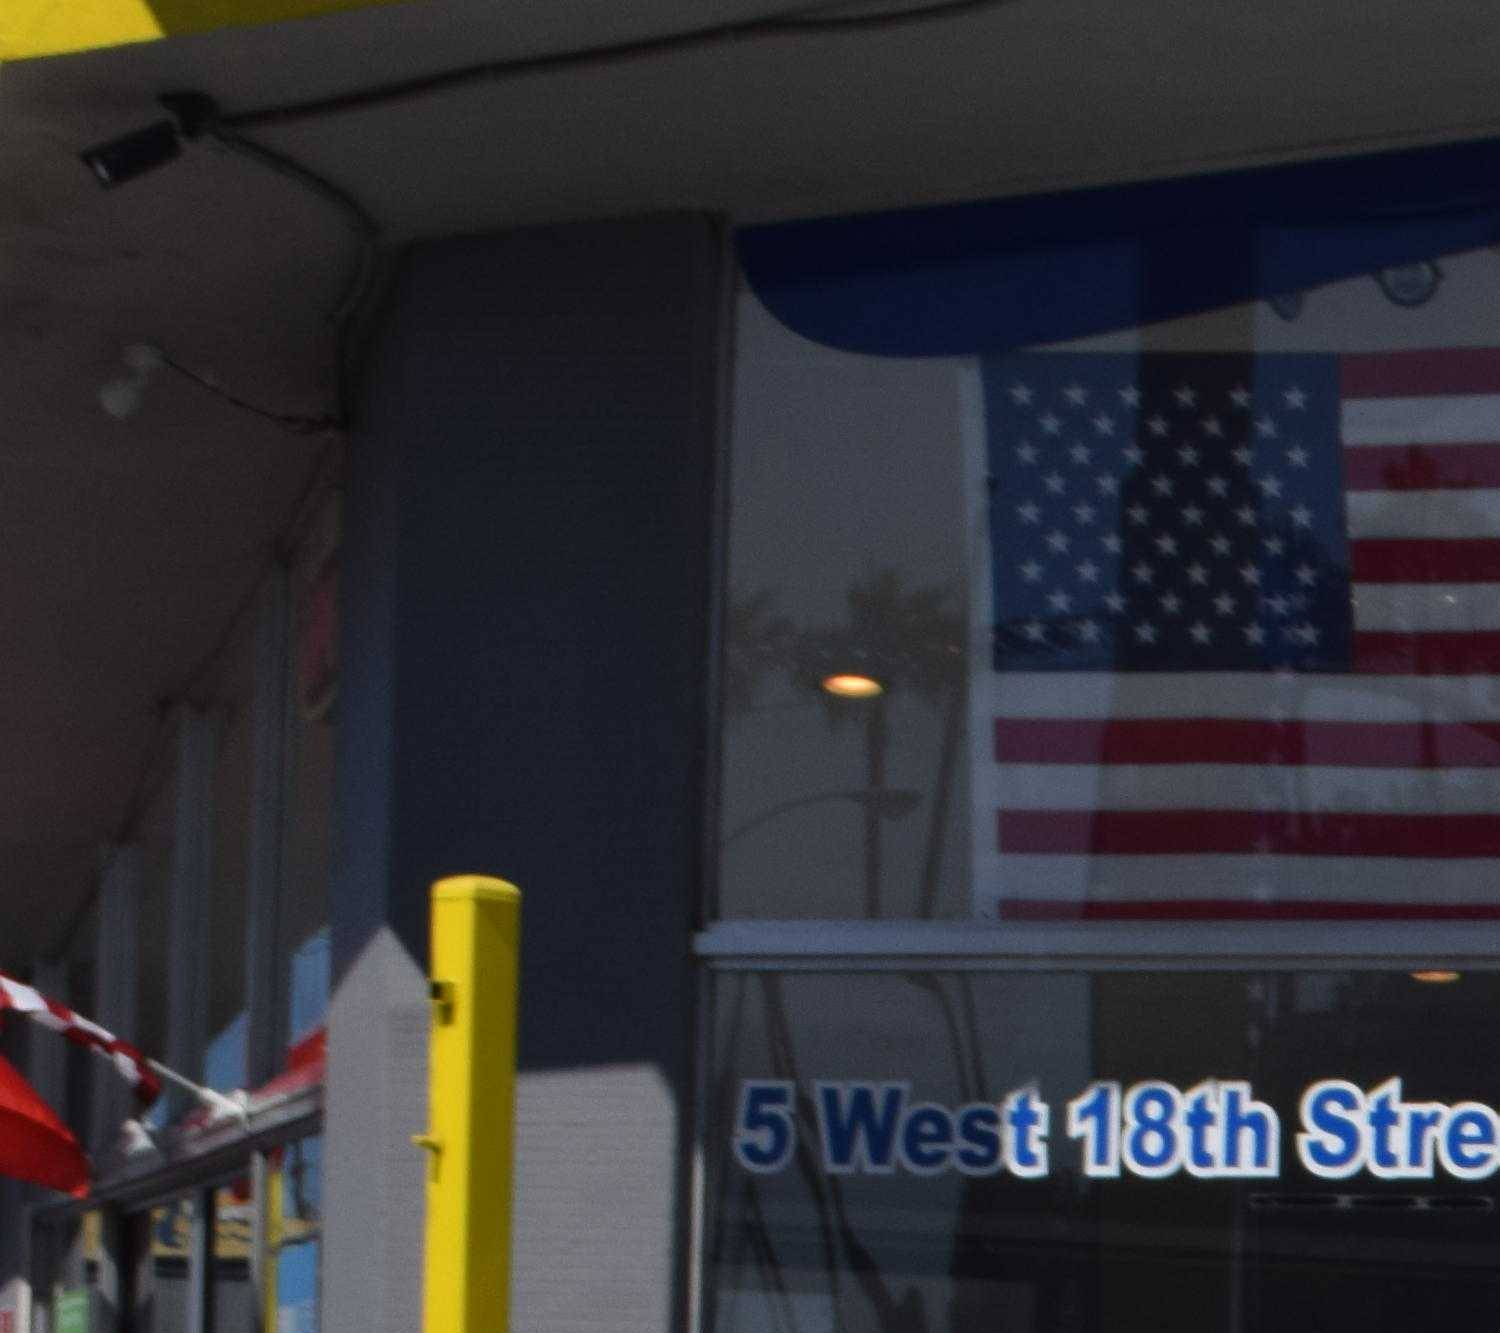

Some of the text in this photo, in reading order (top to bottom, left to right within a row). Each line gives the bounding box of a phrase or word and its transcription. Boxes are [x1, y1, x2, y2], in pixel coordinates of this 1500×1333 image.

[735, 1084, 795, 1171] 5
[815, 1076, 1048, 1176] West
[1068, 1079, 1280, 1177] 18th
